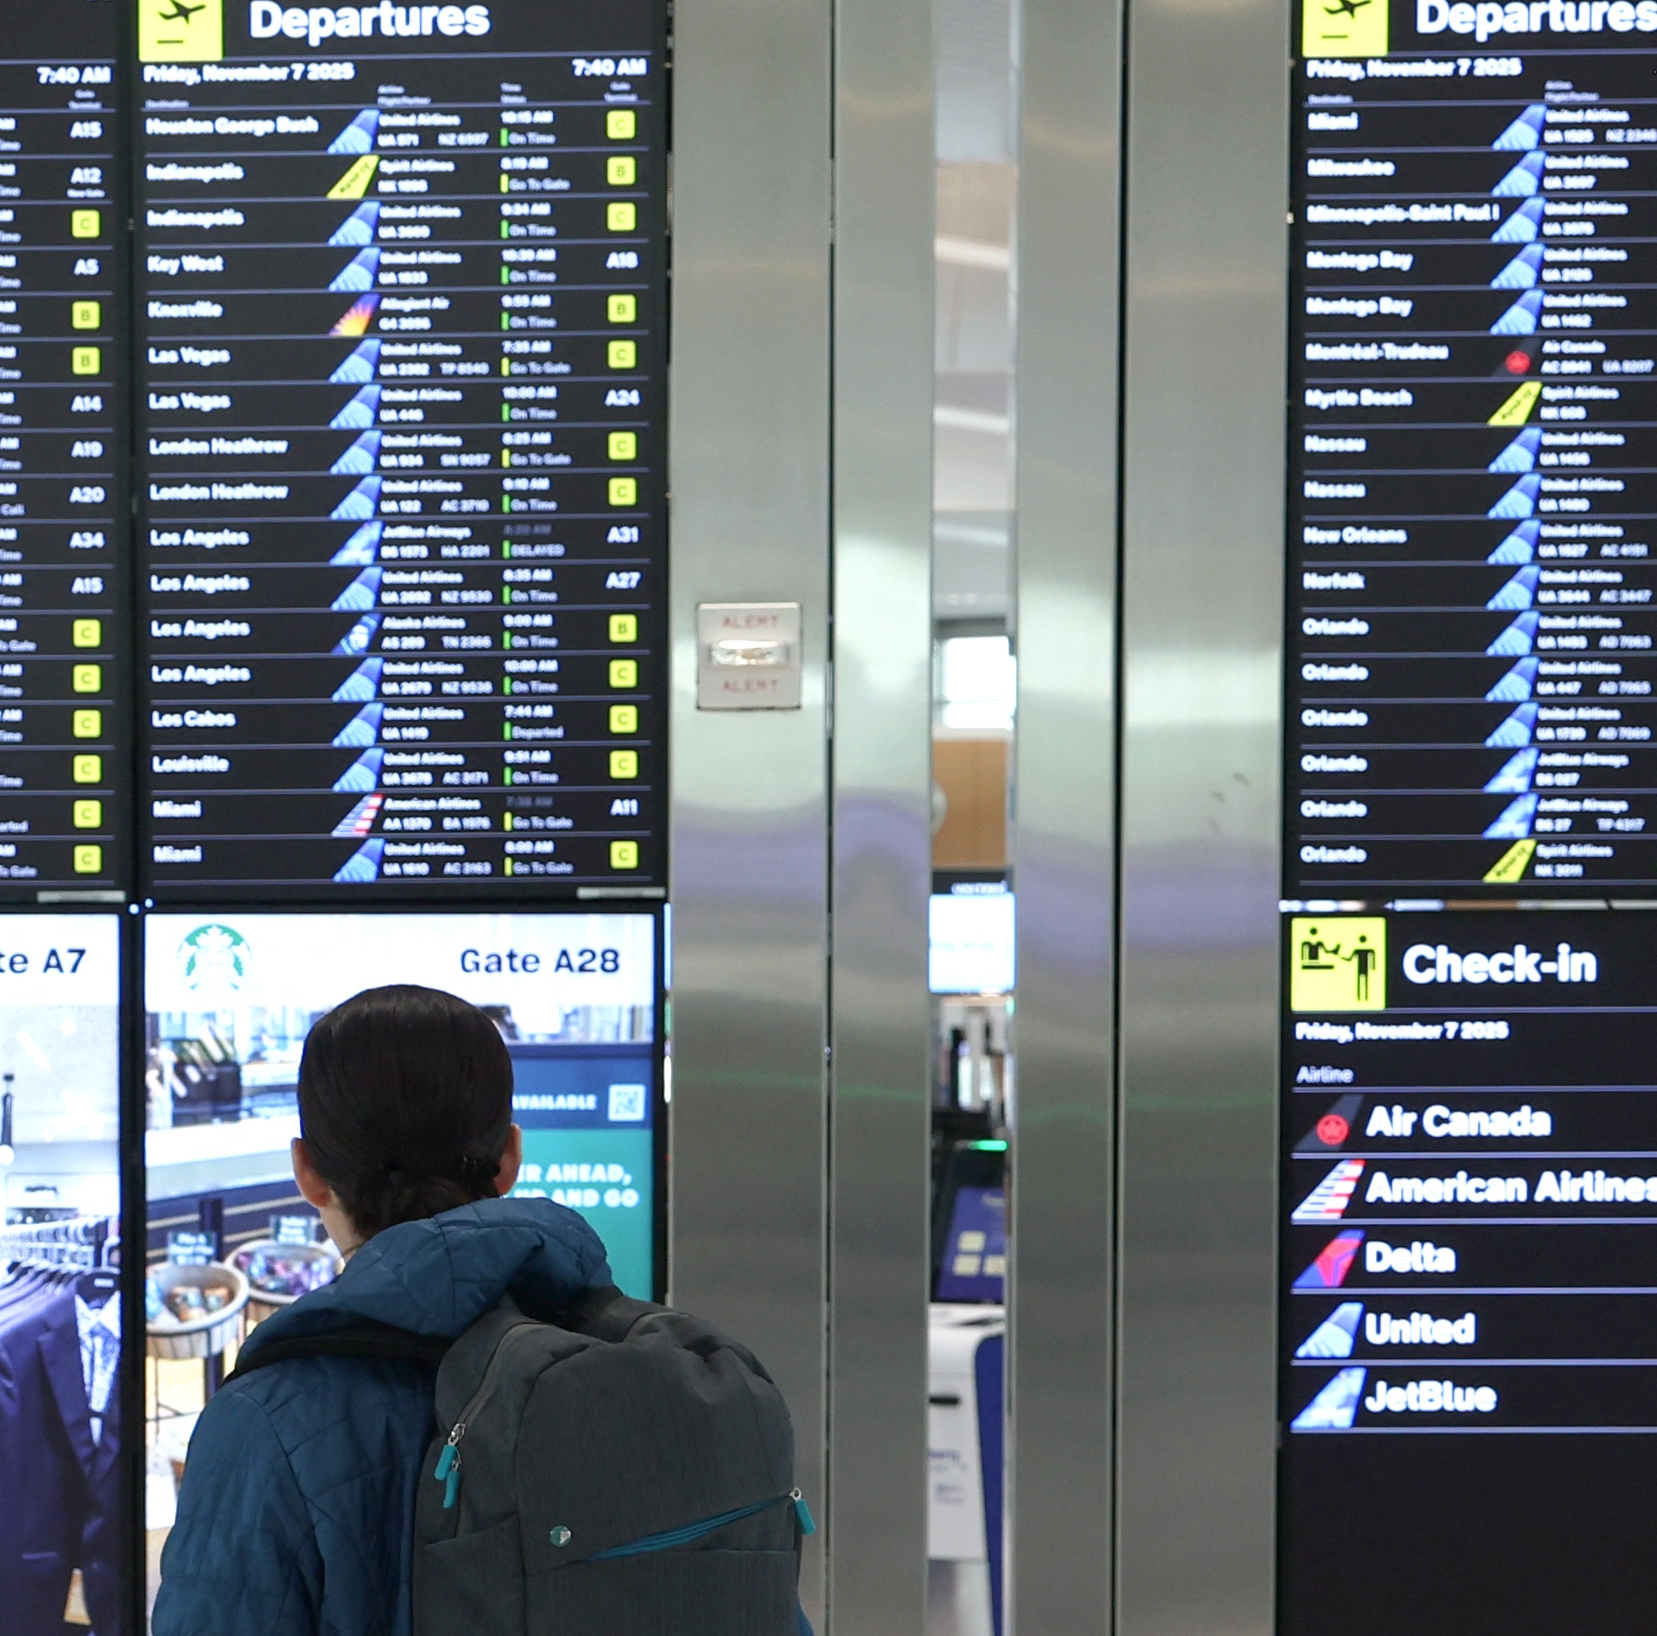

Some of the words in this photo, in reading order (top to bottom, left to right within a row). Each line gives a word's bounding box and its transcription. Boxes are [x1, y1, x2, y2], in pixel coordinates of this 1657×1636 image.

[251, 0, 490, 47] Departures
[37, 67, 80, 84] 7:40
[81, 66, 111, 83] AM
[144, 65, 201, 85] Friday,
[203, 64, 289, 81] November
[291, 63, 305, 80] 7
[307, 63, 355, 80] 2025
[572, 59, 615, 76] 7:40
[617, 58, 646, 75] AM
[1307, 57, 1365, 81] Friday,
[1367, 59, 1456, 77] November
[1457, 58, 1471, 76] 7
[1473, 58, 1522, 76] 2025
[148, 256, 180, 275] Key
[181, 255, 223, 271] West
[70, 532, 104, 548] A34
[150, 529, 181, 546] Los
[182, 529, 249, 548] Angeles
[1304, 527, 1341, 543] New
[1342, 527, 1407, 543] Orleans
[606, 572, 640, 588] A27
[722, 615, 779, 629] ALERT
[1303, 618, 1369, 635] Orlando
[722, 679, 779, 693] ALERT
[153, 801, 201, 817] Miami
[43, 949, 85, 973] A7
[461, 949, 539, 973] Gate
[555, 949, 619, 973] A28
[1403, 943, 1596, 983] Check-in
[1296, 1022, 1354, 1043] Friday,
[1355, 1022, 1443, 1039] November
[1444, 1022, 1459, 1039] 7
[1460, 1021, 1509, 1039] 2025
[1297, 1066, 1353, 1083] Airline
[1366, 1105, 1417, 1136] Air
[1423, 1105, 1551, 1137] Canada
[546, 1164, 632, 1186] AHEAD,
[1366, 1171, 1527, 1202] American
[552, 1189, 599, 1207] AND
[604, 1189, 639, 1207] GO
[1366, 1242, 1455, 1272] Delta
[1366, 1312, 1475, 1344] United
[1365, 1381, 1497, 1412] JetBlue
